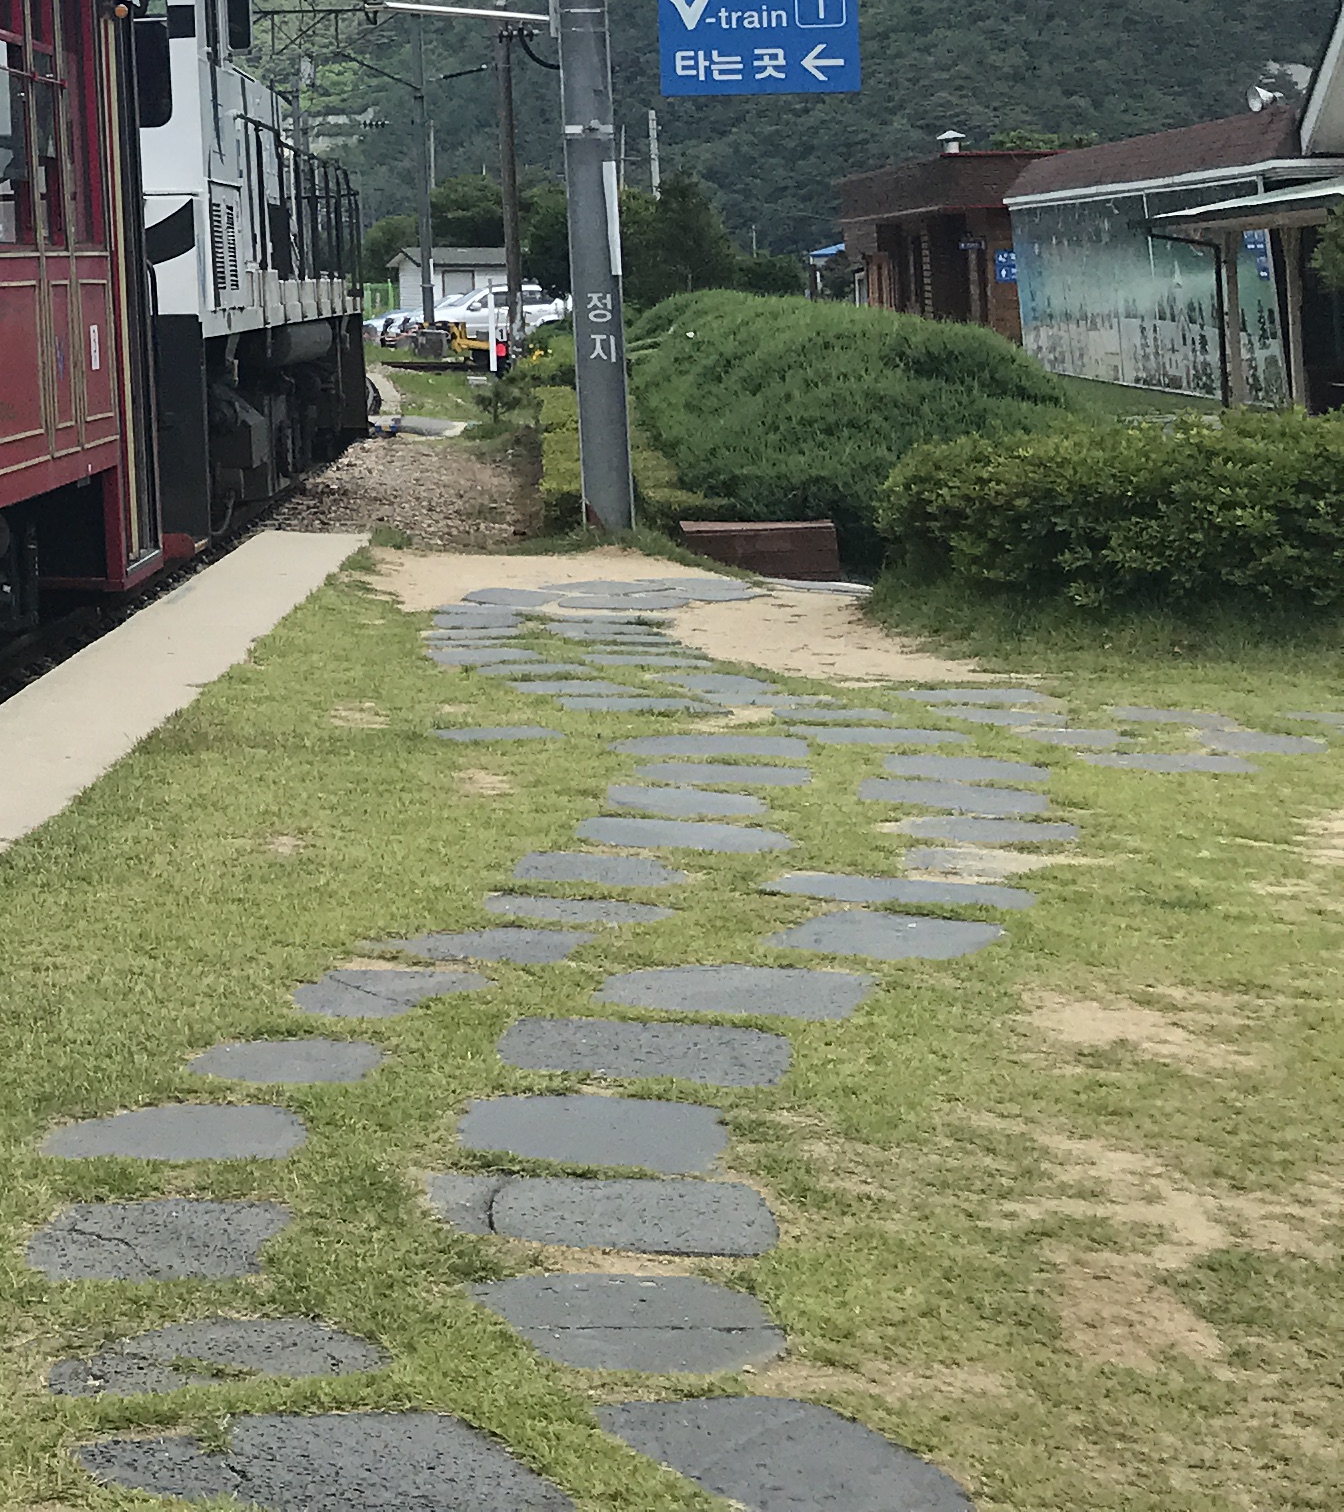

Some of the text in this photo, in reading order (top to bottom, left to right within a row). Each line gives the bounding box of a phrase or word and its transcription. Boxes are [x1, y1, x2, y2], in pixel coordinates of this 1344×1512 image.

[674, 48, 787, 81] 타는 곳
[586, 292, 617, 363] 정지
